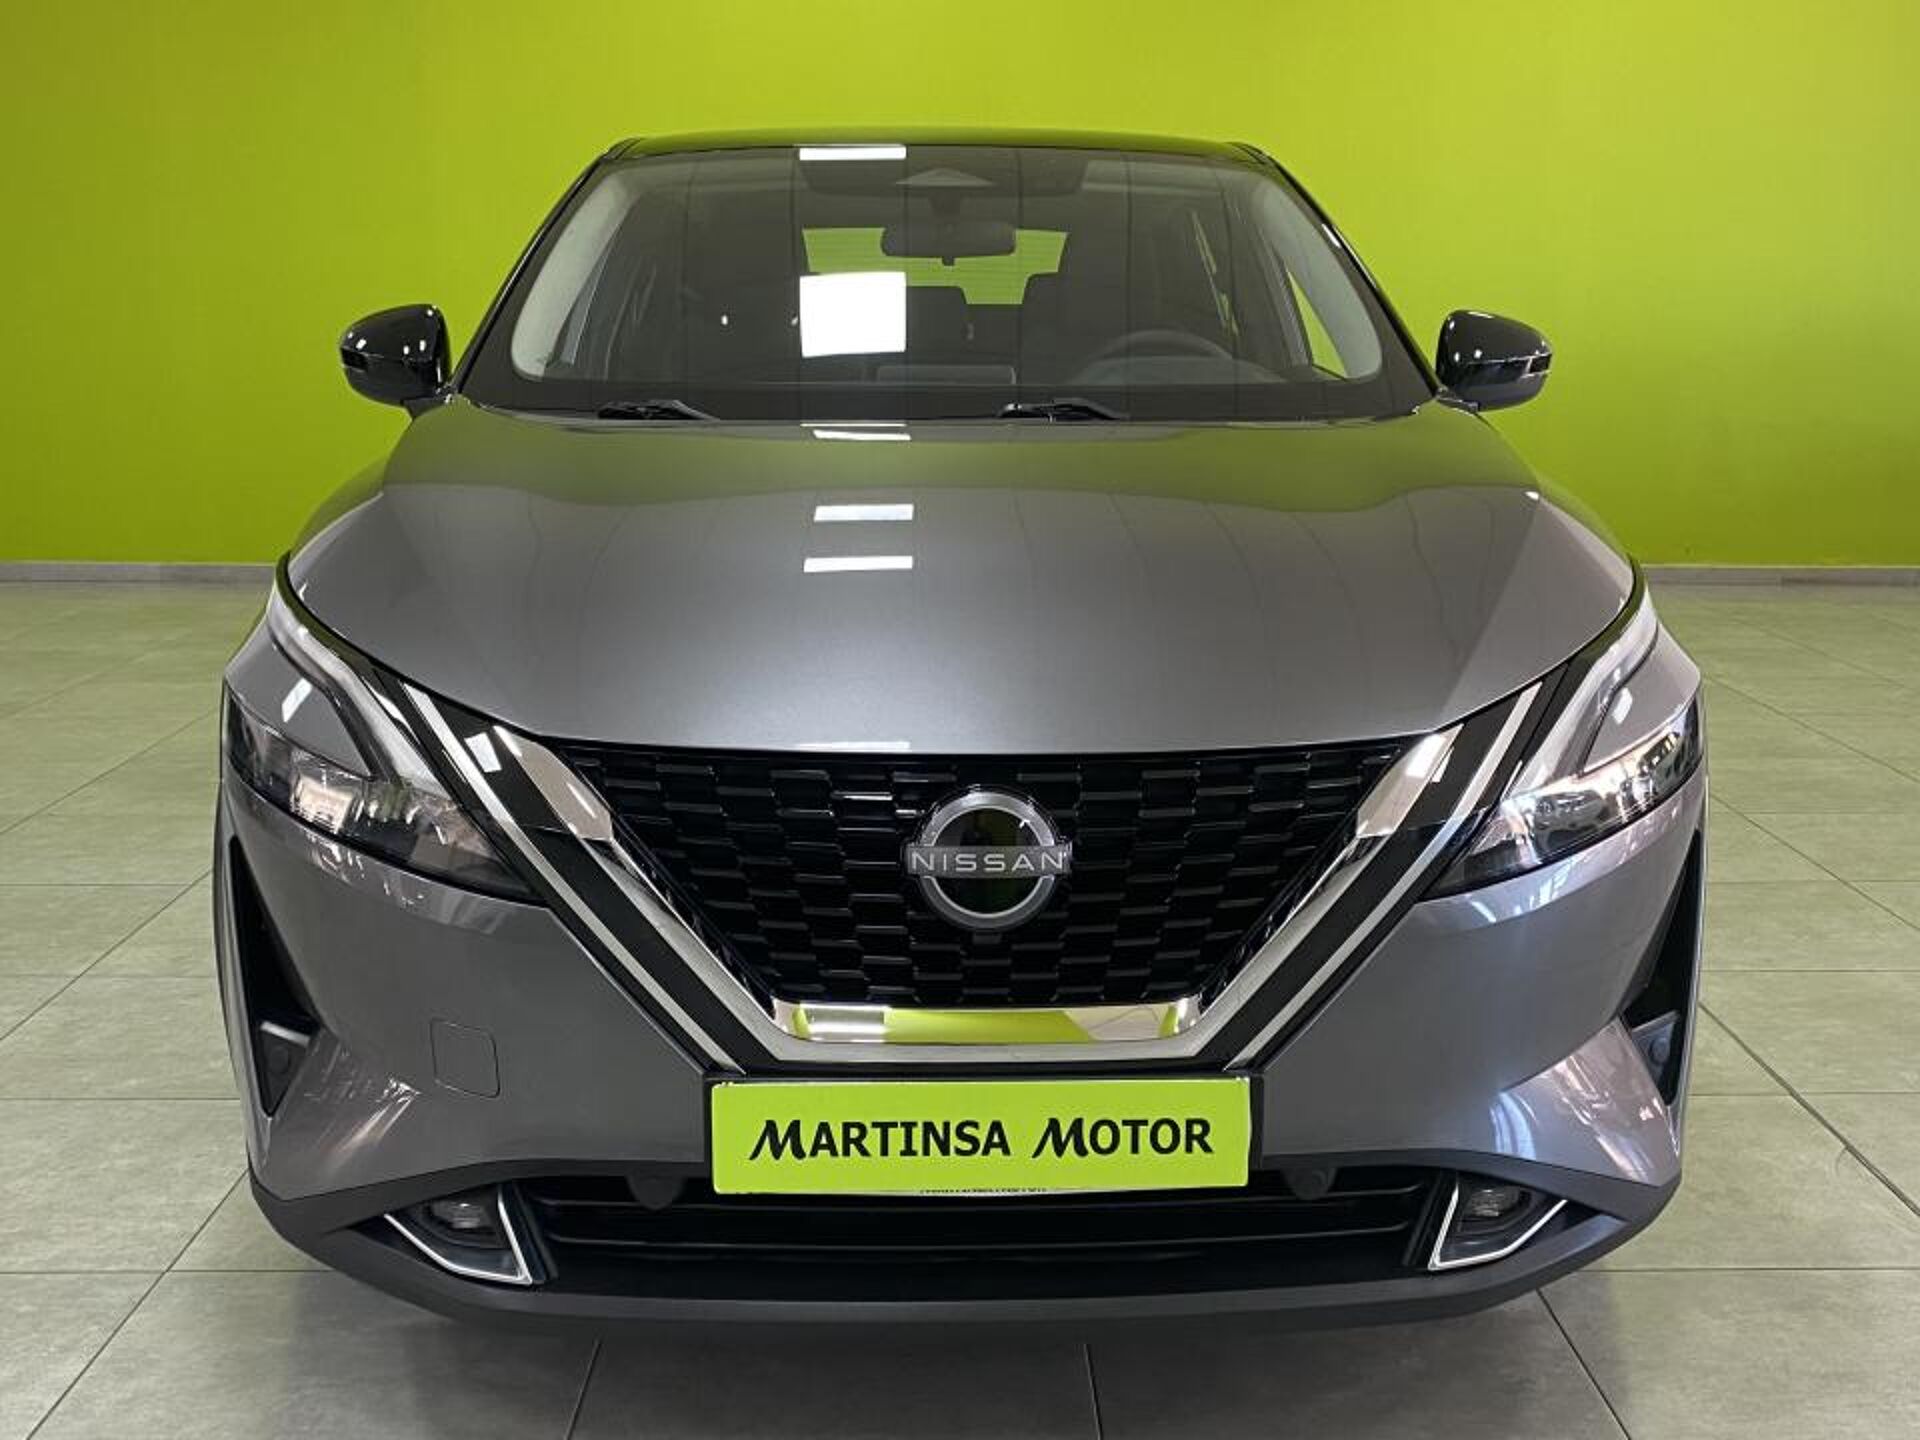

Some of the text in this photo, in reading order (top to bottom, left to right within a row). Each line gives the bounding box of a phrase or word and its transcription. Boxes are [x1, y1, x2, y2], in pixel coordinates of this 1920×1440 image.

[911, 852, 1063, 872] NISSAN
[749, 1117, 1214, 1160] MARTINSA MOTOR
